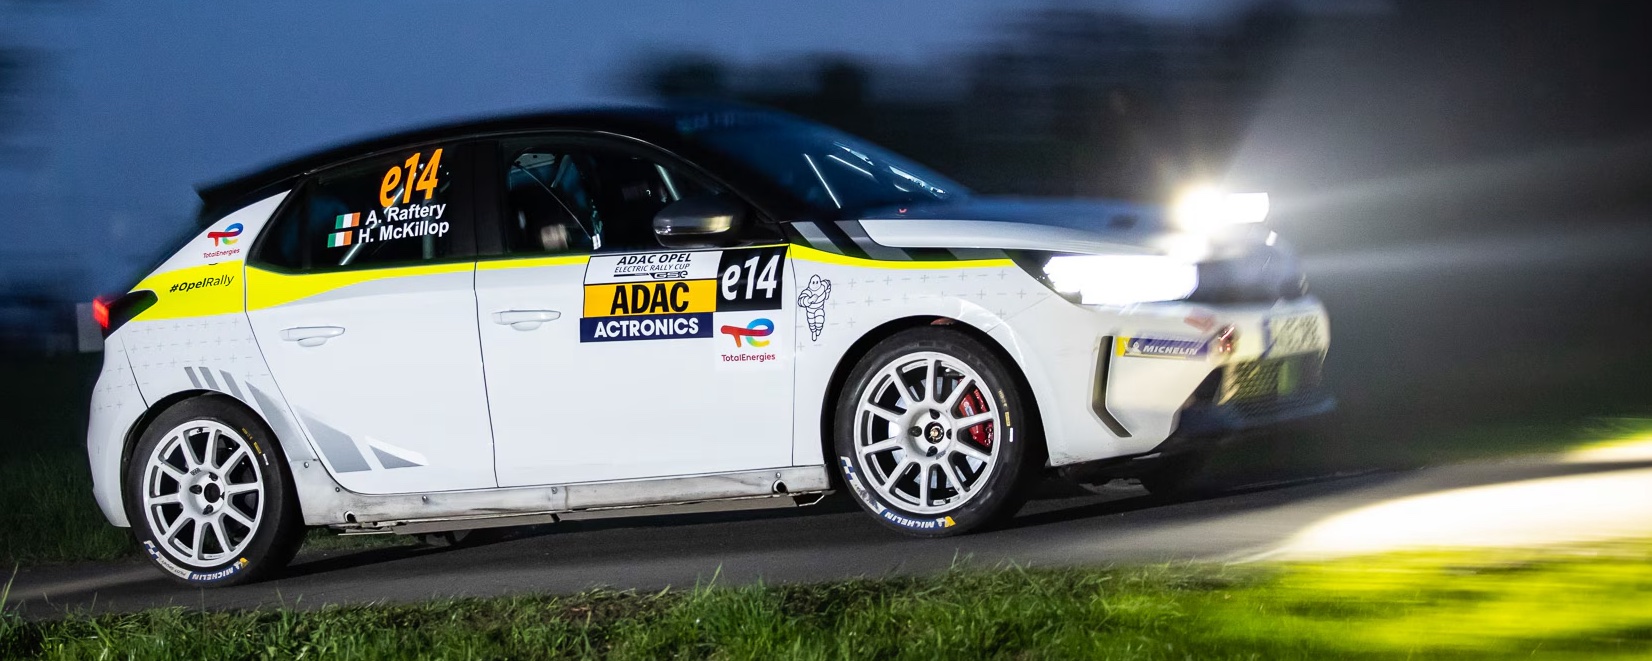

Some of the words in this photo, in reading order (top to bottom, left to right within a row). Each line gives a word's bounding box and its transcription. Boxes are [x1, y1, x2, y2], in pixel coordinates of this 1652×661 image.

[379, 148, 443, 208] e14
[365, 209, 382, 228] A.
[386, 203, 446, 223] Raftery
[358, 228, 374, 243] H.
[379, 220, 449, 242] McKillop
[203, 248, 240, 259] TotalEnergies
[617, 254, 656, 265] ADAC
[658, 253, 692, 263] OPEL
[614, 264, 648, 273] ELECTRIC
[649, 263, 673, 272] RALLY
[169, 274, 235, 293] #OpelRally
[721, 254, 779, 301] e14
[610, 282, 689, 315] ADAC
[593, 317, 699, 338] ACTRONICS
[721, 353, 776, 363] TotalEnergies
[1142, 345, 1199, 356] MICHELIN
[885, 511, 935, 529] MICHELIN
[192, 566, 235, 581] MICHELIN
